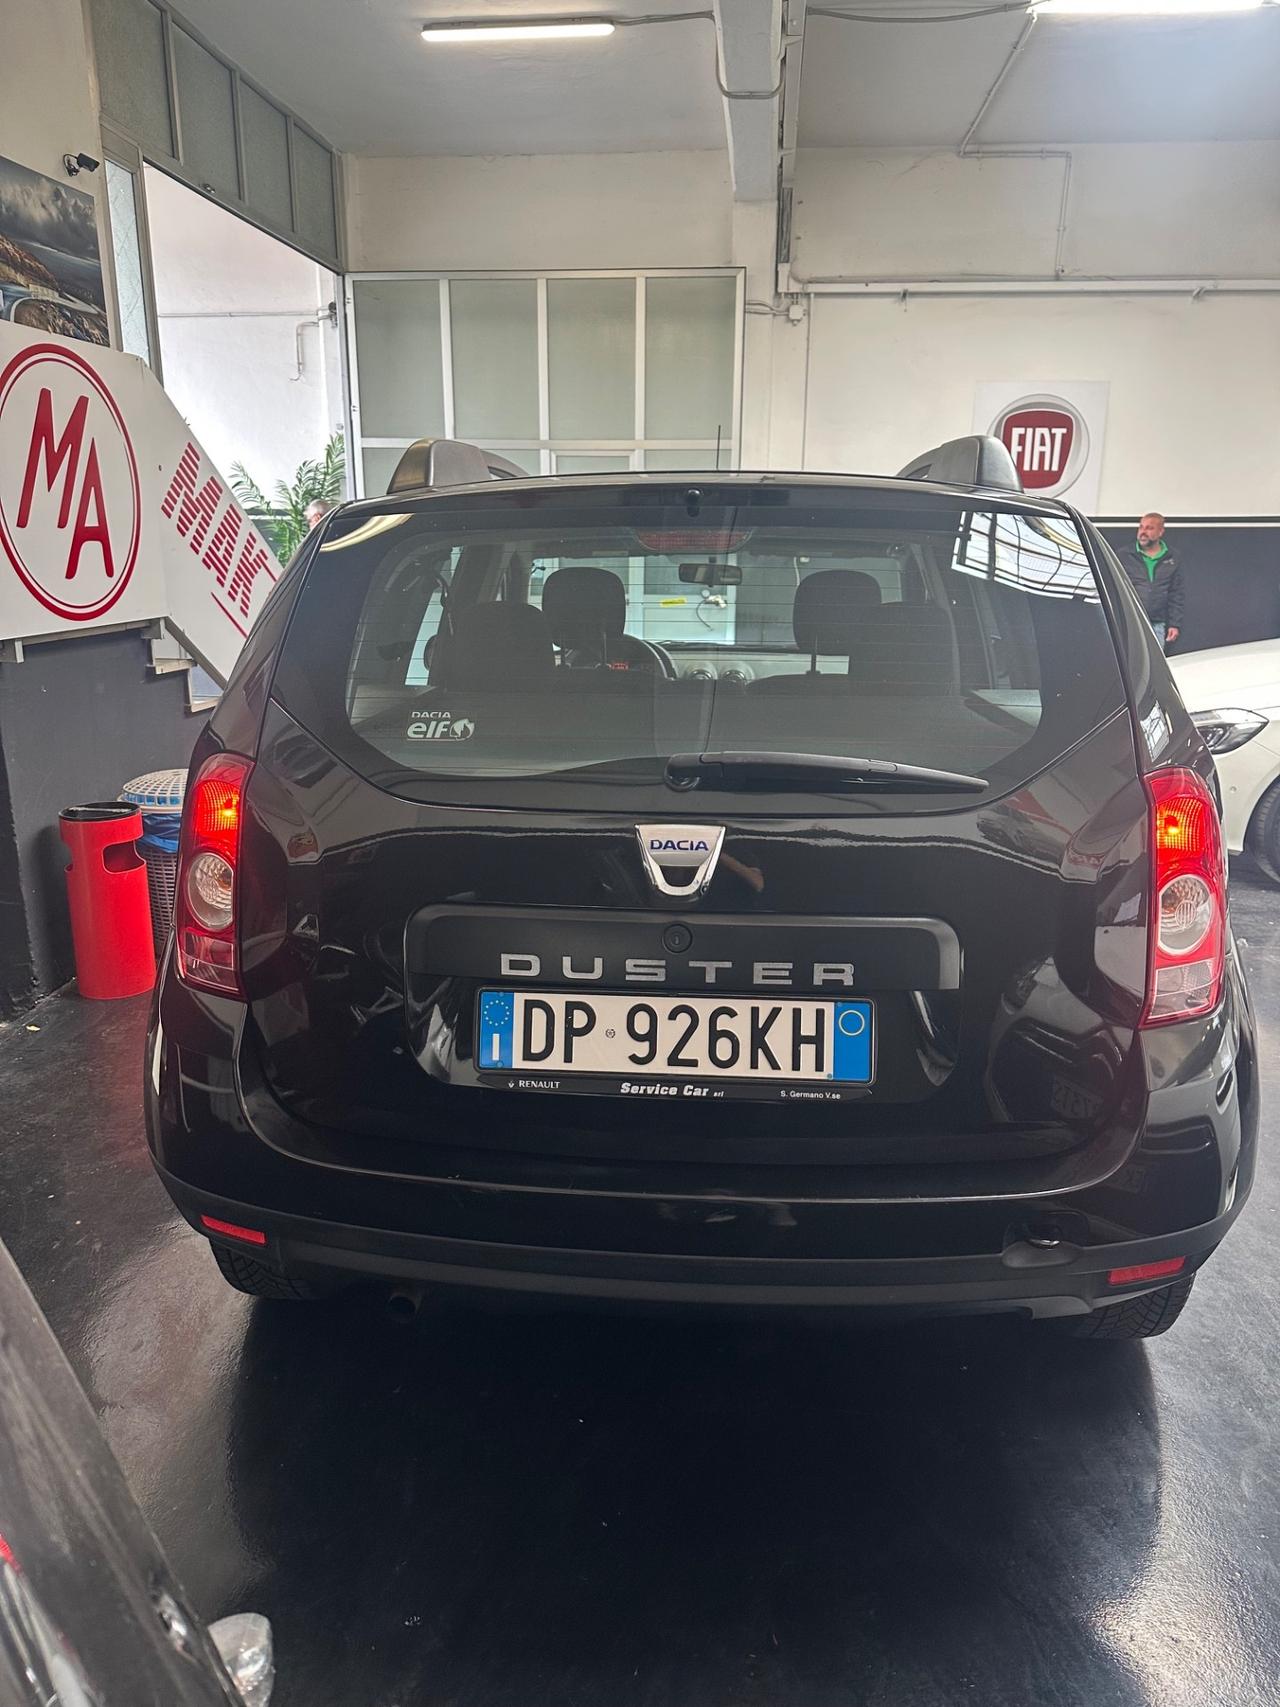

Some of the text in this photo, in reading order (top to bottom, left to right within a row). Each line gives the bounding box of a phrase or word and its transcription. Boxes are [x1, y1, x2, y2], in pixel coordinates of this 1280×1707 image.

[1011, 427, 1067, 471] FIAT
[16, 387, 115, 580] MA
[160, 441, 269, 618] MAK
[411, 711, 451, 719] DACIA
[407, 720, 451, 739] elf
[650, 839, 709, 851] DACIA
[500, 953, 855, 986] DUSTER
[518, 1079, 561, 1090] RENAULT
[620, 1082, 678, 1096] Service
[683, 1084, 710, 1097] Car
[780, 1090, 788, 1098] S.
[790, 1090, 824, 1100] Germano
